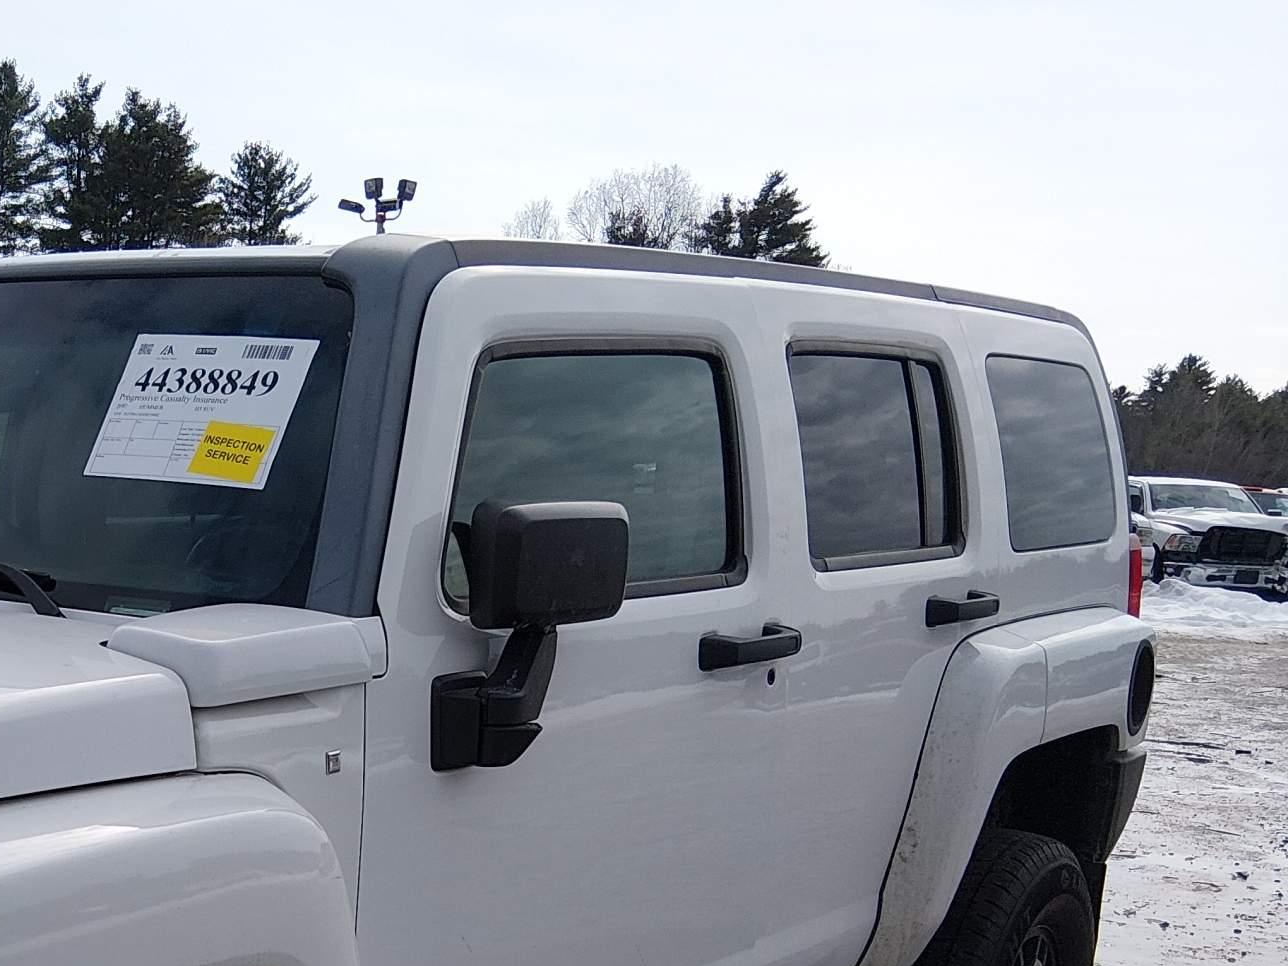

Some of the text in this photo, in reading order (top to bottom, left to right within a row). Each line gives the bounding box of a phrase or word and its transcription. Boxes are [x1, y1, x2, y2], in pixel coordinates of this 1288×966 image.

[134, 367, 280, 397] 44388849
[119, 393, 229, 404] Progressive Casualty Insurance
[203, 434, 265, 453] INSPECTION
[205, 449, 251, 465] SERVICE
